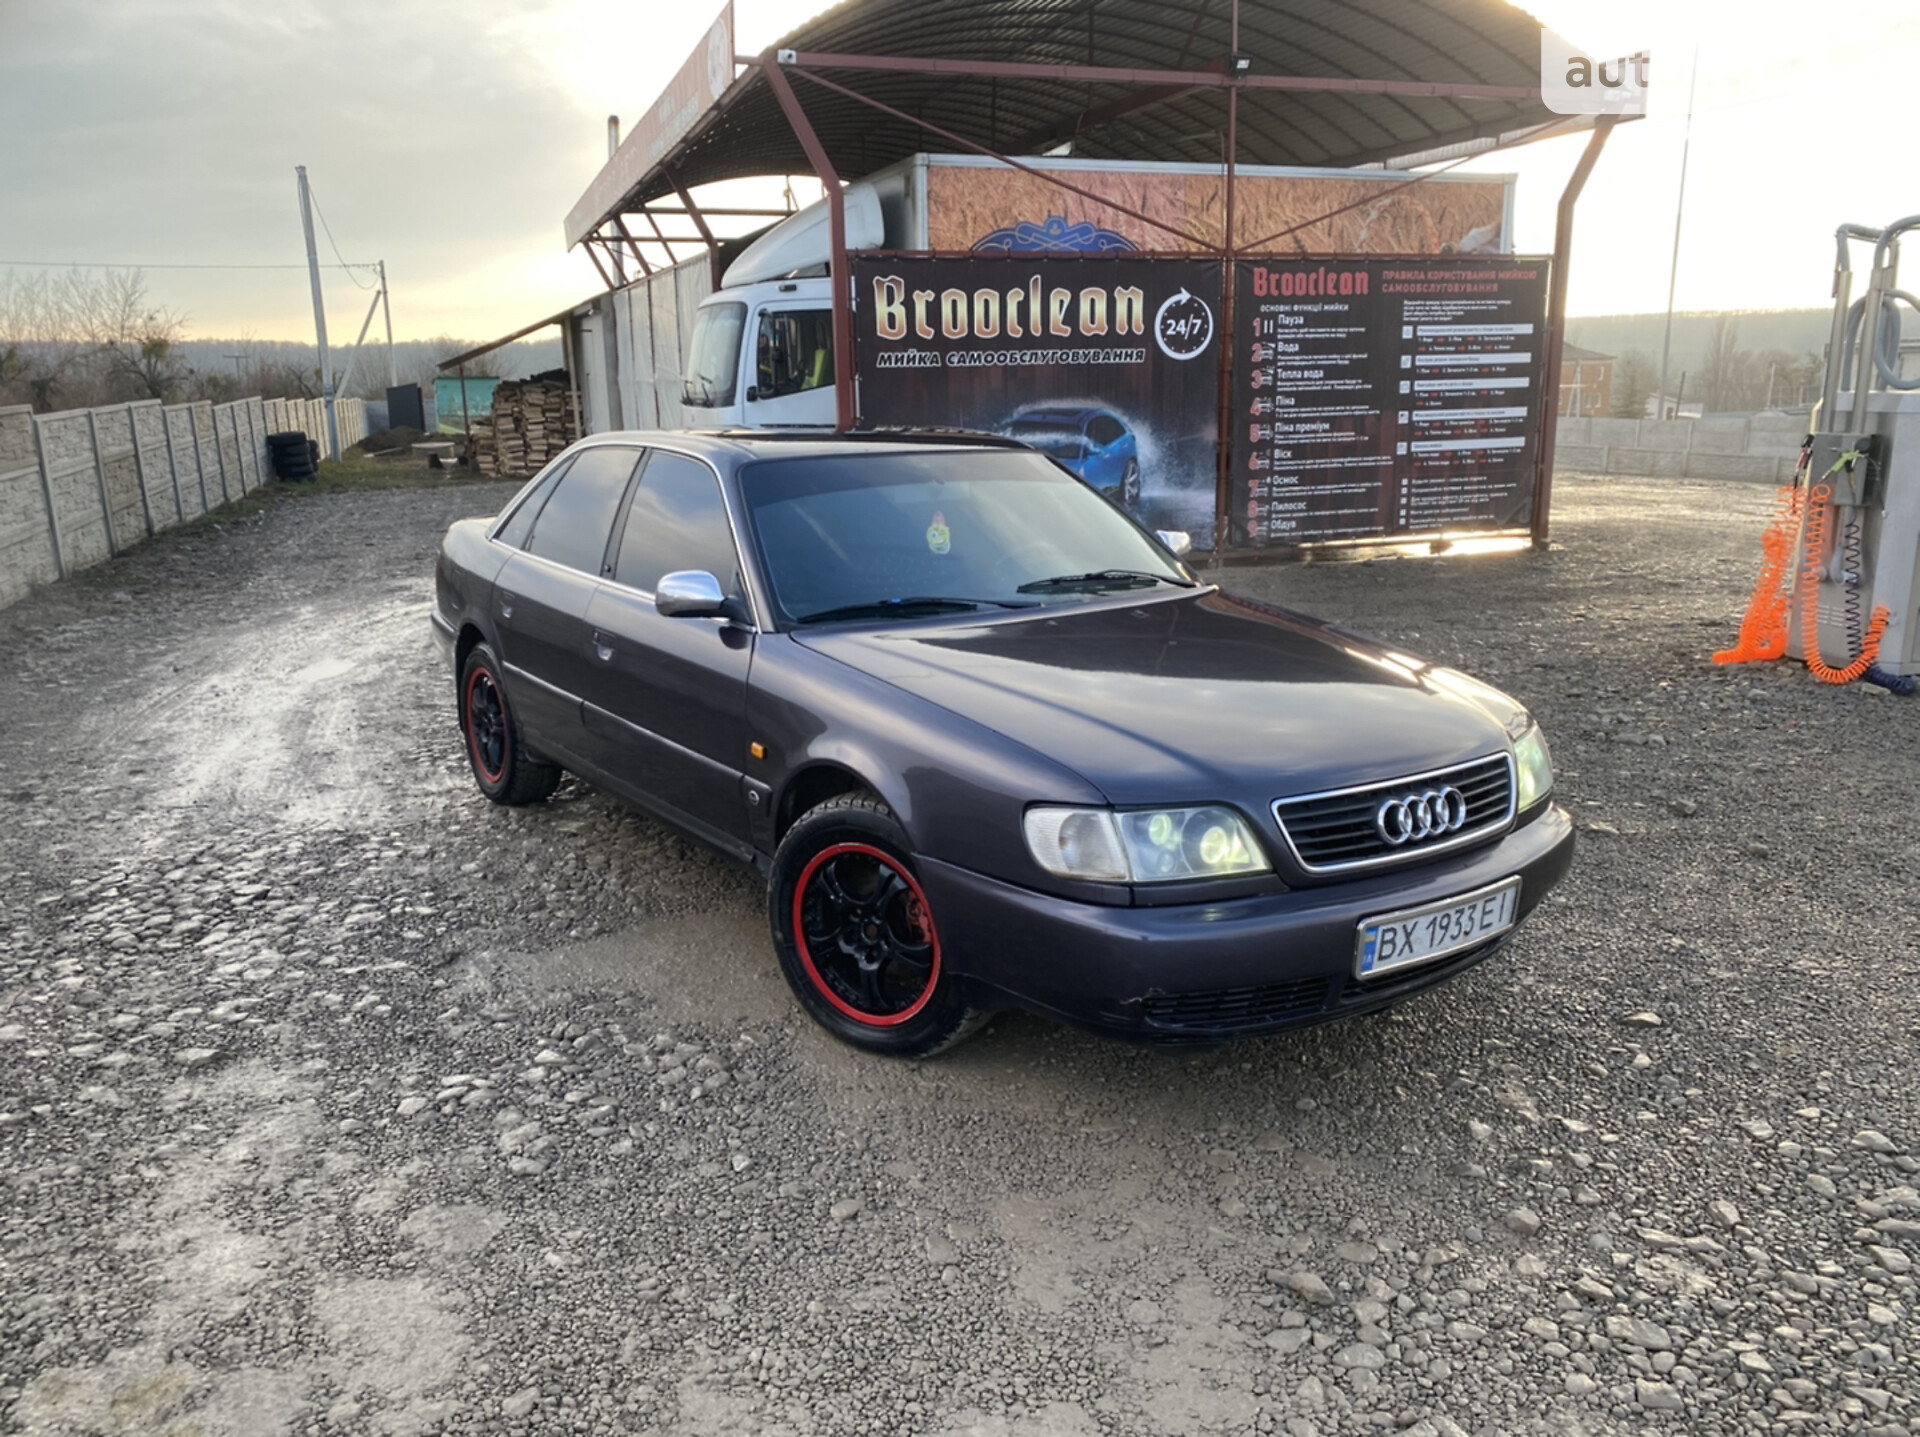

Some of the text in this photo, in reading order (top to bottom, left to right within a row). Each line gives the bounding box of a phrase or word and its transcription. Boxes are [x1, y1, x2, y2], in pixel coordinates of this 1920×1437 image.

[1253, 266, 1369, 296] Brooclean
[1382, 270, 1425, 280] ПРАВИЛА
[1427, 270, 1497, 280] КОРИСТУВАННЯ
[1382, 283, 1498, 293] САМООБСЛУГОВУВАННЯ
[873, 274, 1145, 340] Brooclean
[1260, 304, 1291, 312] ОСНОВНІ
[1166, 314, 1202, 340] 24/7
[1253, 317, 1261, 337] 1
[1278, 314, 1304, 326] Пауза
[876, 348, 1146, 368] МИЙКА САМООБСЛУГОВУВАННЯ
[1251, 343, 1262, 362] 2
[1277, 341, 1299, 353] Вода
[1251, 369, 1324, 389] 3 Тепла вода
[1249, 397, 1261, 416] 4
[1272, 475, 1299, 485] Осмос
[1271, 501, 1307, 511] Пилосос
[1270, 519, 1296, 531] Обдув
[1426, 904, 1477, 948] 1933
